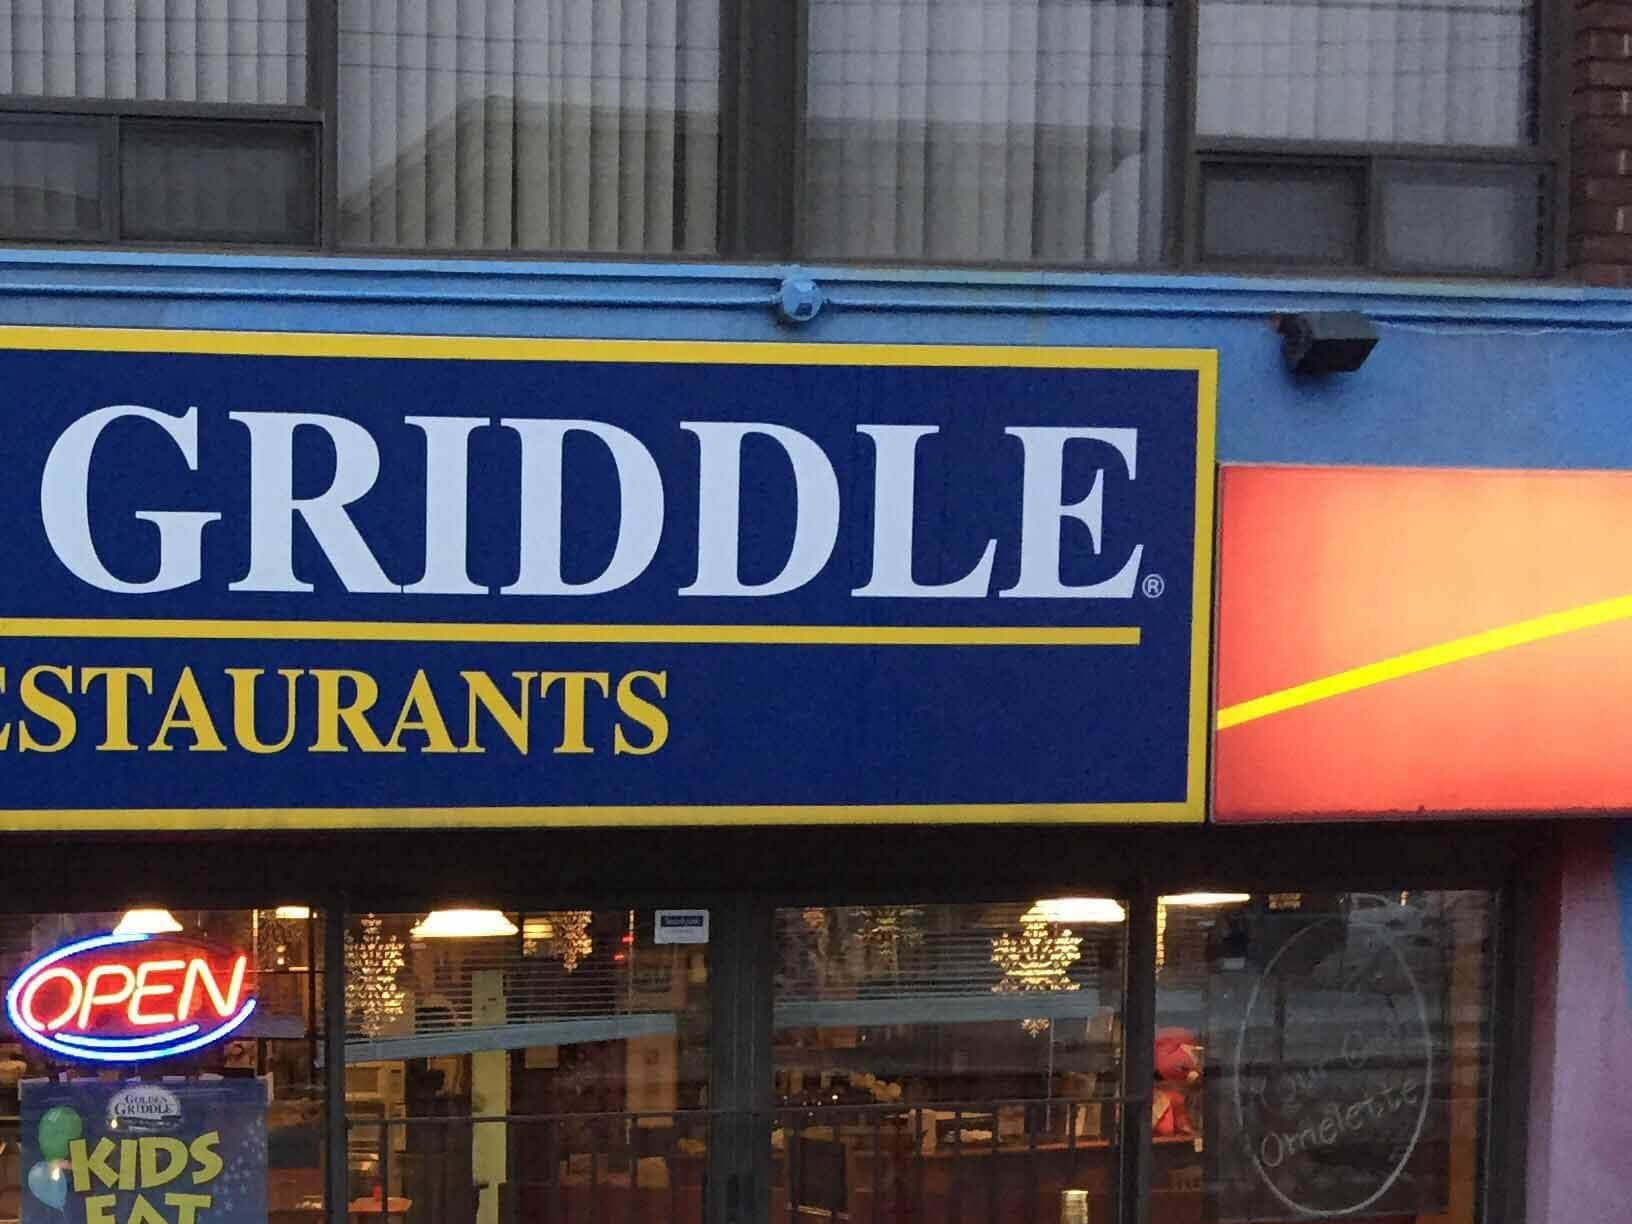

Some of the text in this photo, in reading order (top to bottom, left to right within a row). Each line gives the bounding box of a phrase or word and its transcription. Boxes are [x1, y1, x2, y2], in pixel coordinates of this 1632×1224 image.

[22, 956, 247, 1031] OPEN
[1261, 1078, 1419, 1167] Omelette
[68, 1131, 223, 1192] KIDS
